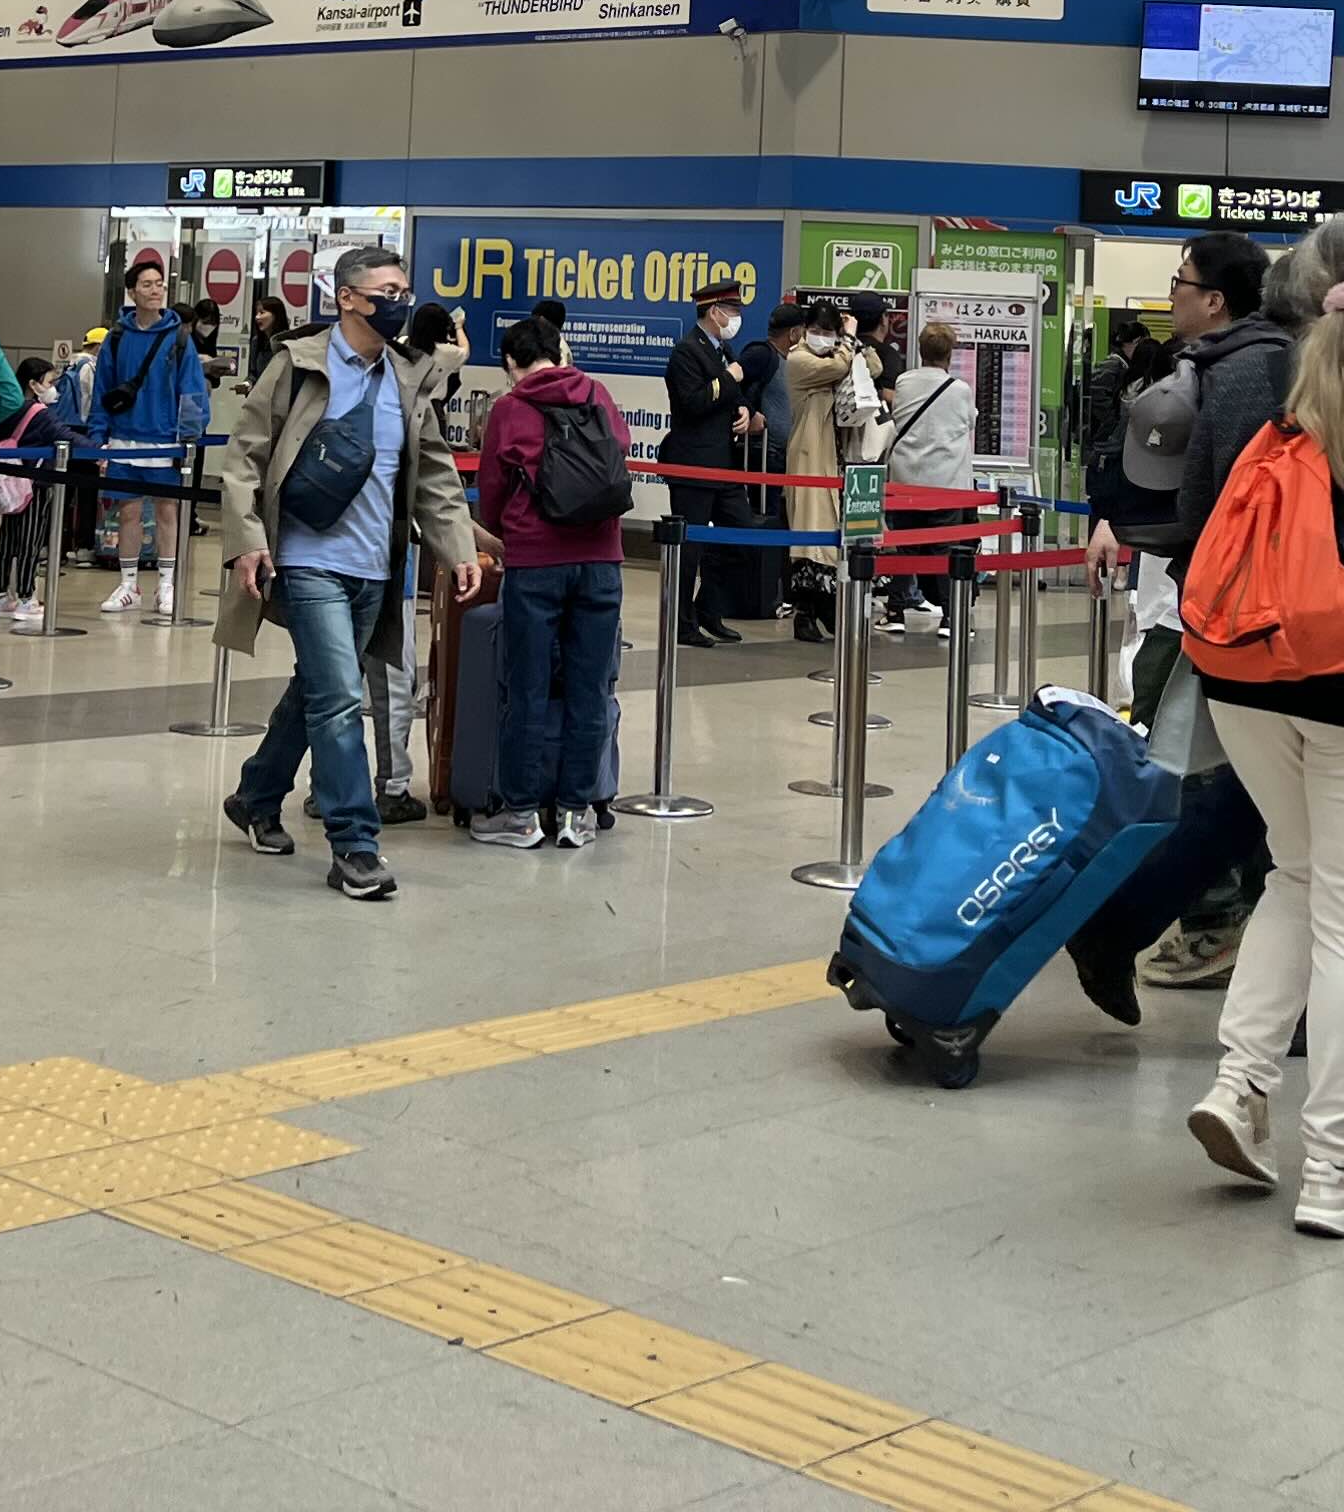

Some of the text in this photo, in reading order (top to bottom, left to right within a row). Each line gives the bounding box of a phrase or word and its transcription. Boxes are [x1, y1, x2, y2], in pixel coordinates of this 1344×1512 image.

[317, 3, 401, 21] Kansai-airport
[599, 3, 680, 19] Shinkansen
[181, 169, 206, 192] JR
[235, 187, 261, 197] Tickets
[1115, 181, 1161, 209] JR
[1218, 187, 1320, 208] きっぷうりば
[1218, 207, 1265, 220] Tickets
[834, 246, 891, 259] みどりの窓口
[940, 243, 1057, 261] みどりの窓口ご利用の
[433, 238, 513, 299] JR
[524, 248, 634, 300] Ticket
[956, 304, 1002, 317] はるか
[974, 328, 1027, 341] HARUKA
[850, 474, 879, 495] 入口
[957, 807, 1064, 926] OSPREY
